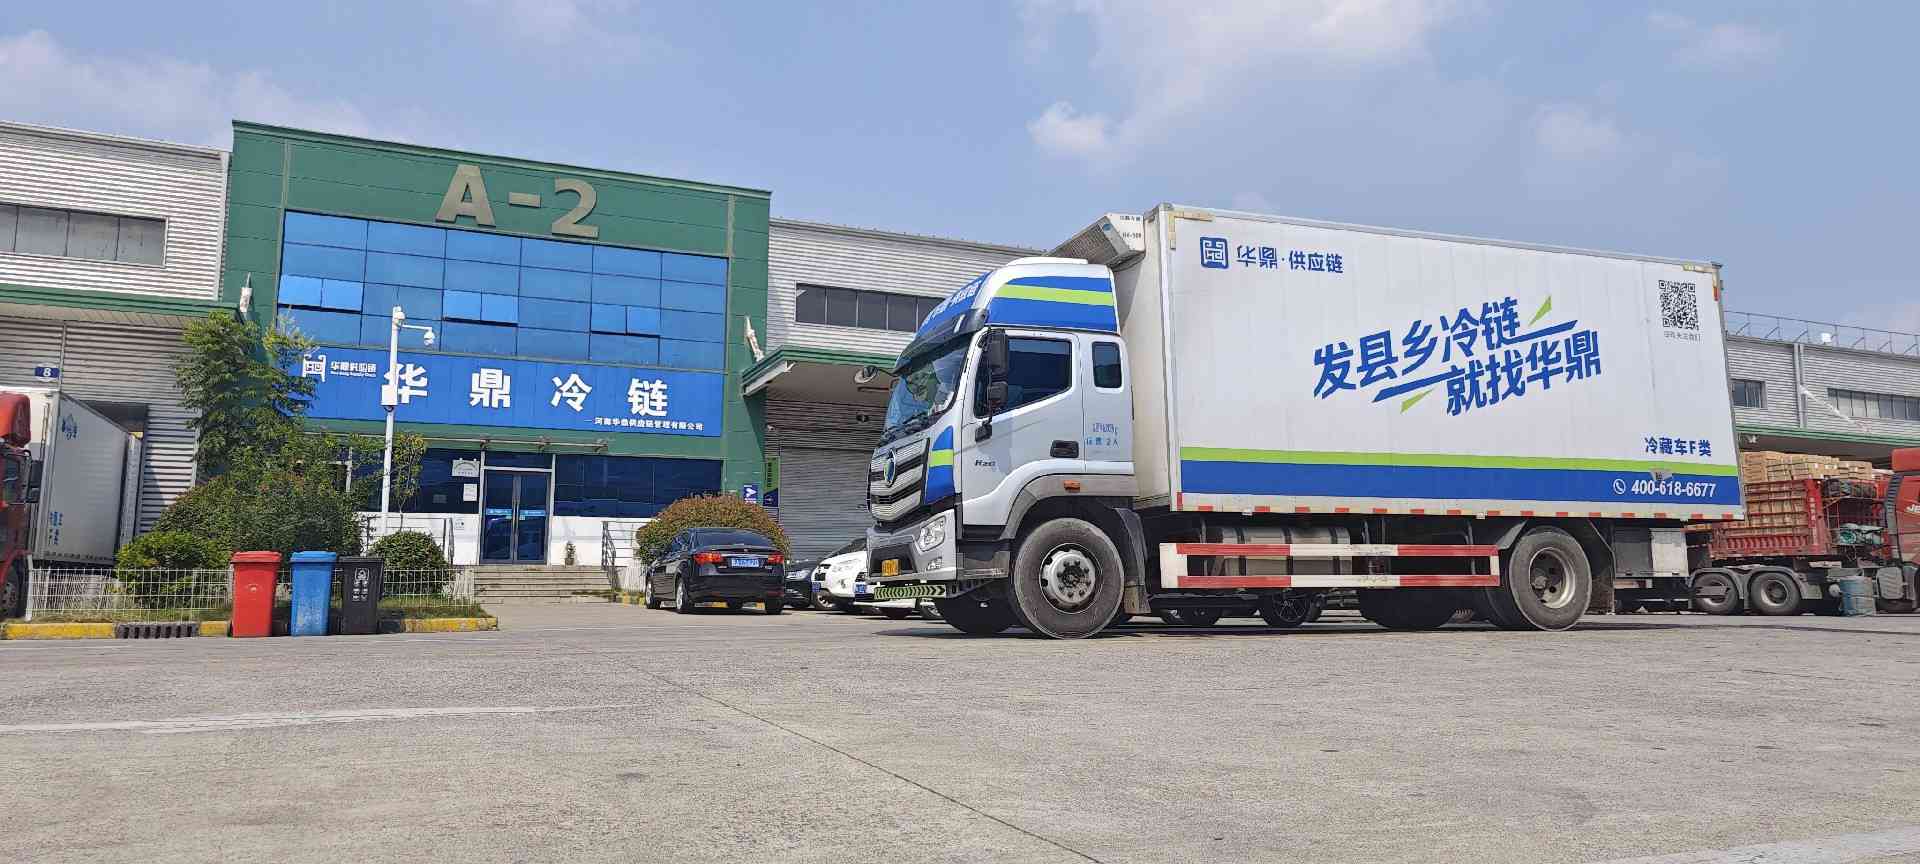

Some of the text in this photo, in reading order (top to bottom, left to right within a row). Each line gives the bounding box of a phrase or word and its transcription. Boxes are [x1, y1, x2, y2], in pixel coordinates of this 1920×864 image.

[435, 163, 599, 239] A-2
[42, 367, 52, 377] 8
[1313, 296, 1521, 400] 发县乡冷链
[1446, 330, 1602, 417] 就找华鼎
[383, 363, 668, 417] 华鼎冷链
[1645, 436, 1712, 457] 冷藏车F类
[1631, 479, 1716, 498] 400-618-6677
